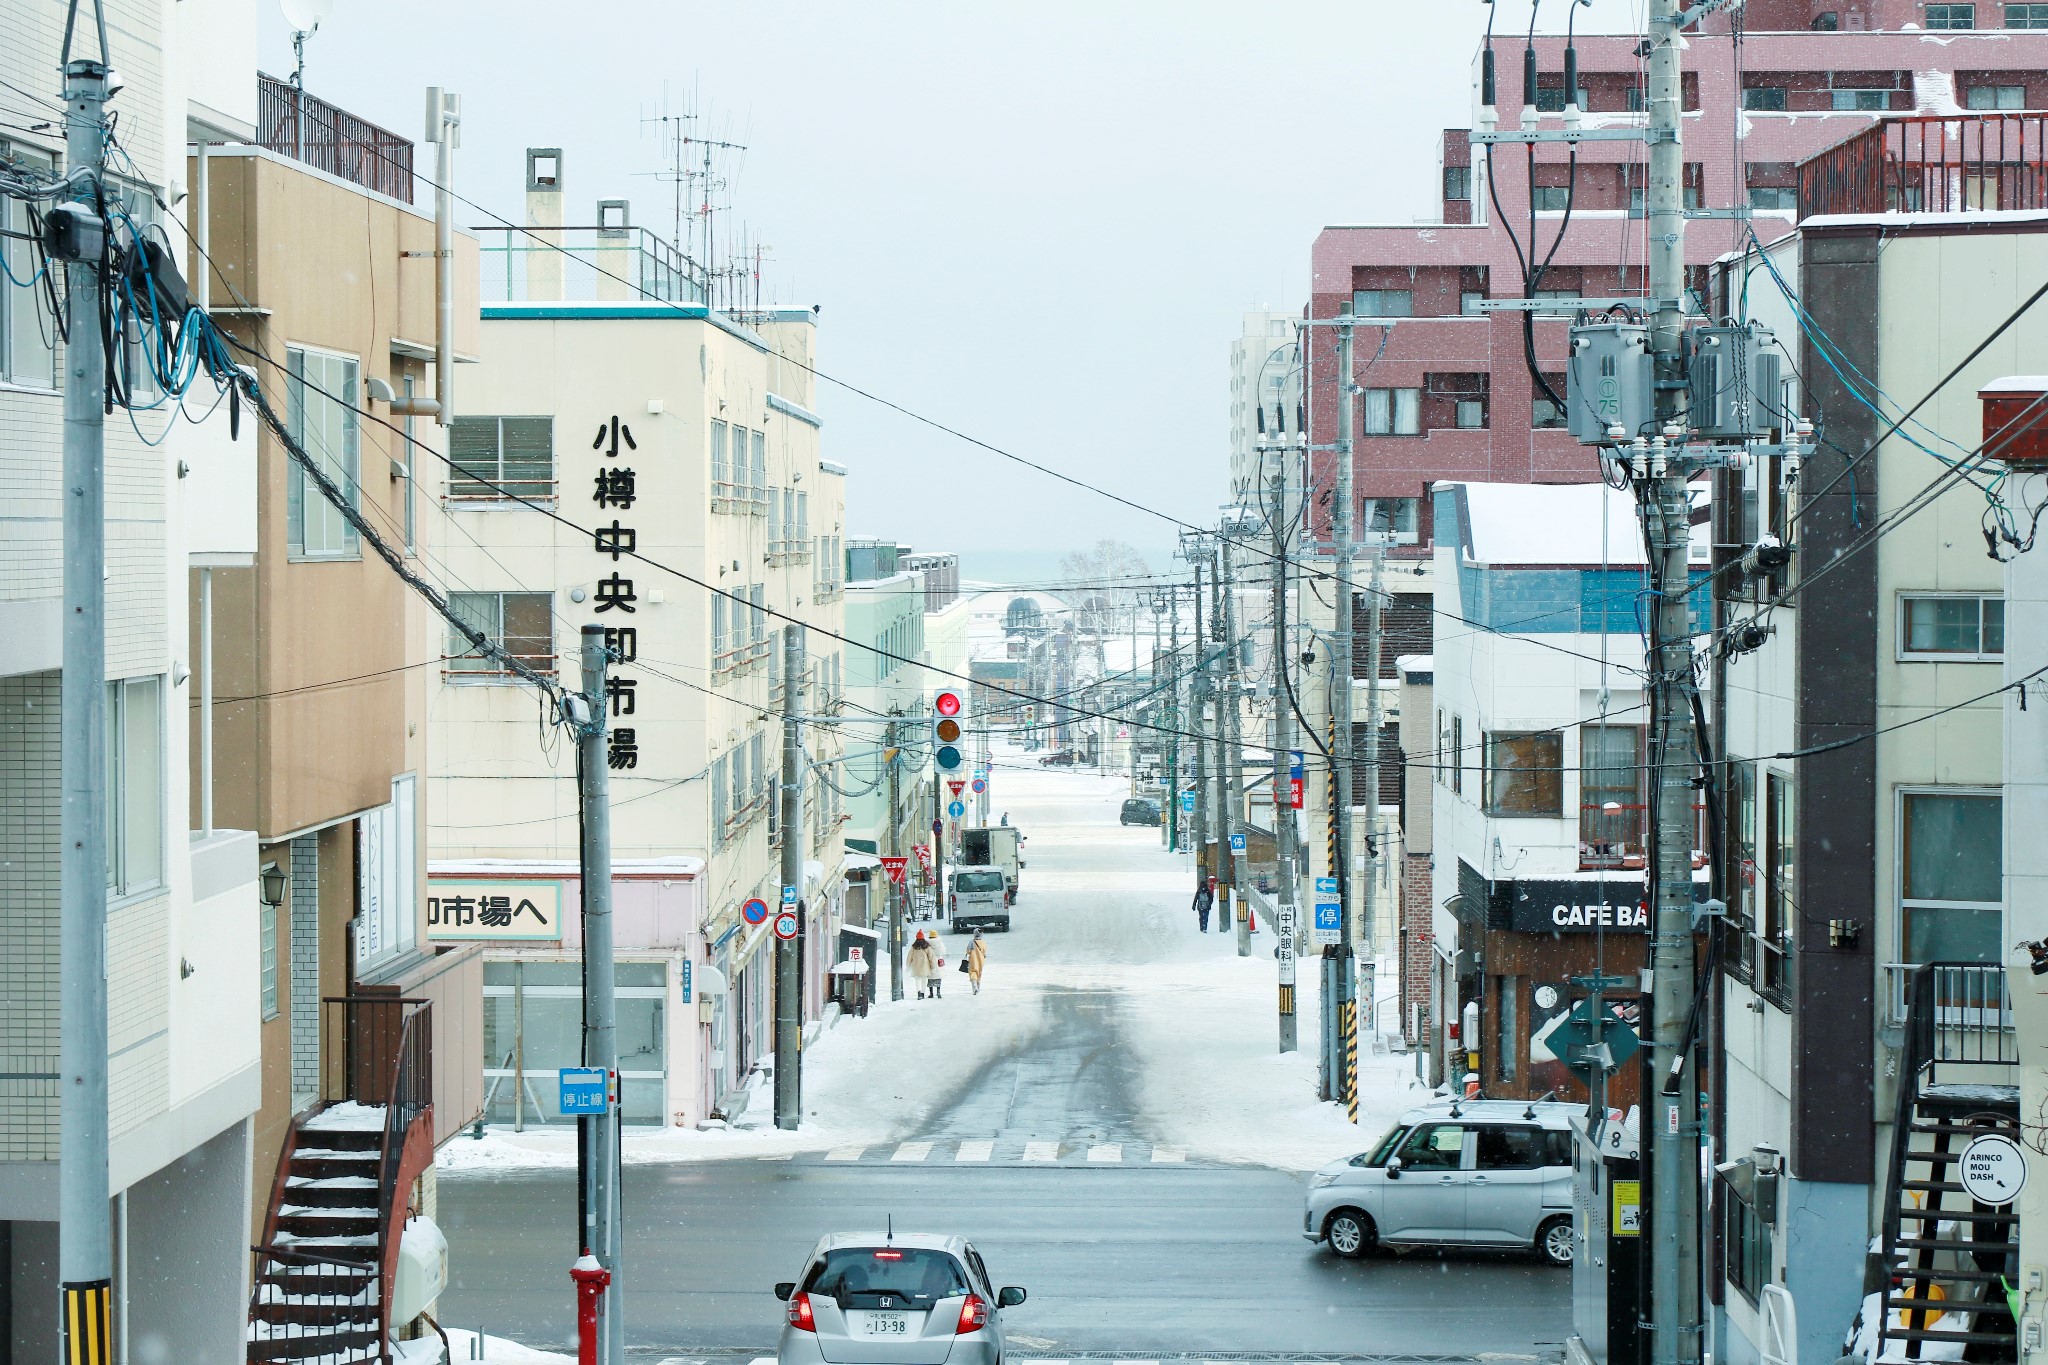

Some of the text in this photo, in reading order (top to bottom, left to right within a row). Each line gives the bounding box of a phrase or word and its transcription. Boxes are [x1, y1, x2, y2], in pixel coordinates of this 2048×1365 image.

[1599, 400, 1618, 415] 75
[1730, 401, 1750, 417] 75
[592, 415, 638, 770] 小樽中央卸市場
[1232, 836, 1244, 848] 停
[885, 861, 904, 869] 止まれ
[1318, 907, 1337, 926] 停
[1552, 900, 1612, 926] CAFÉ
[779, 920, 795, 933] 30
[1280, 913, 1292, 962] 中央眼科
[850, 948, 861, 961] 危
[563, 1092, 603, 1107] 停止線
[875, 1320, 905, 1332] 13-98
